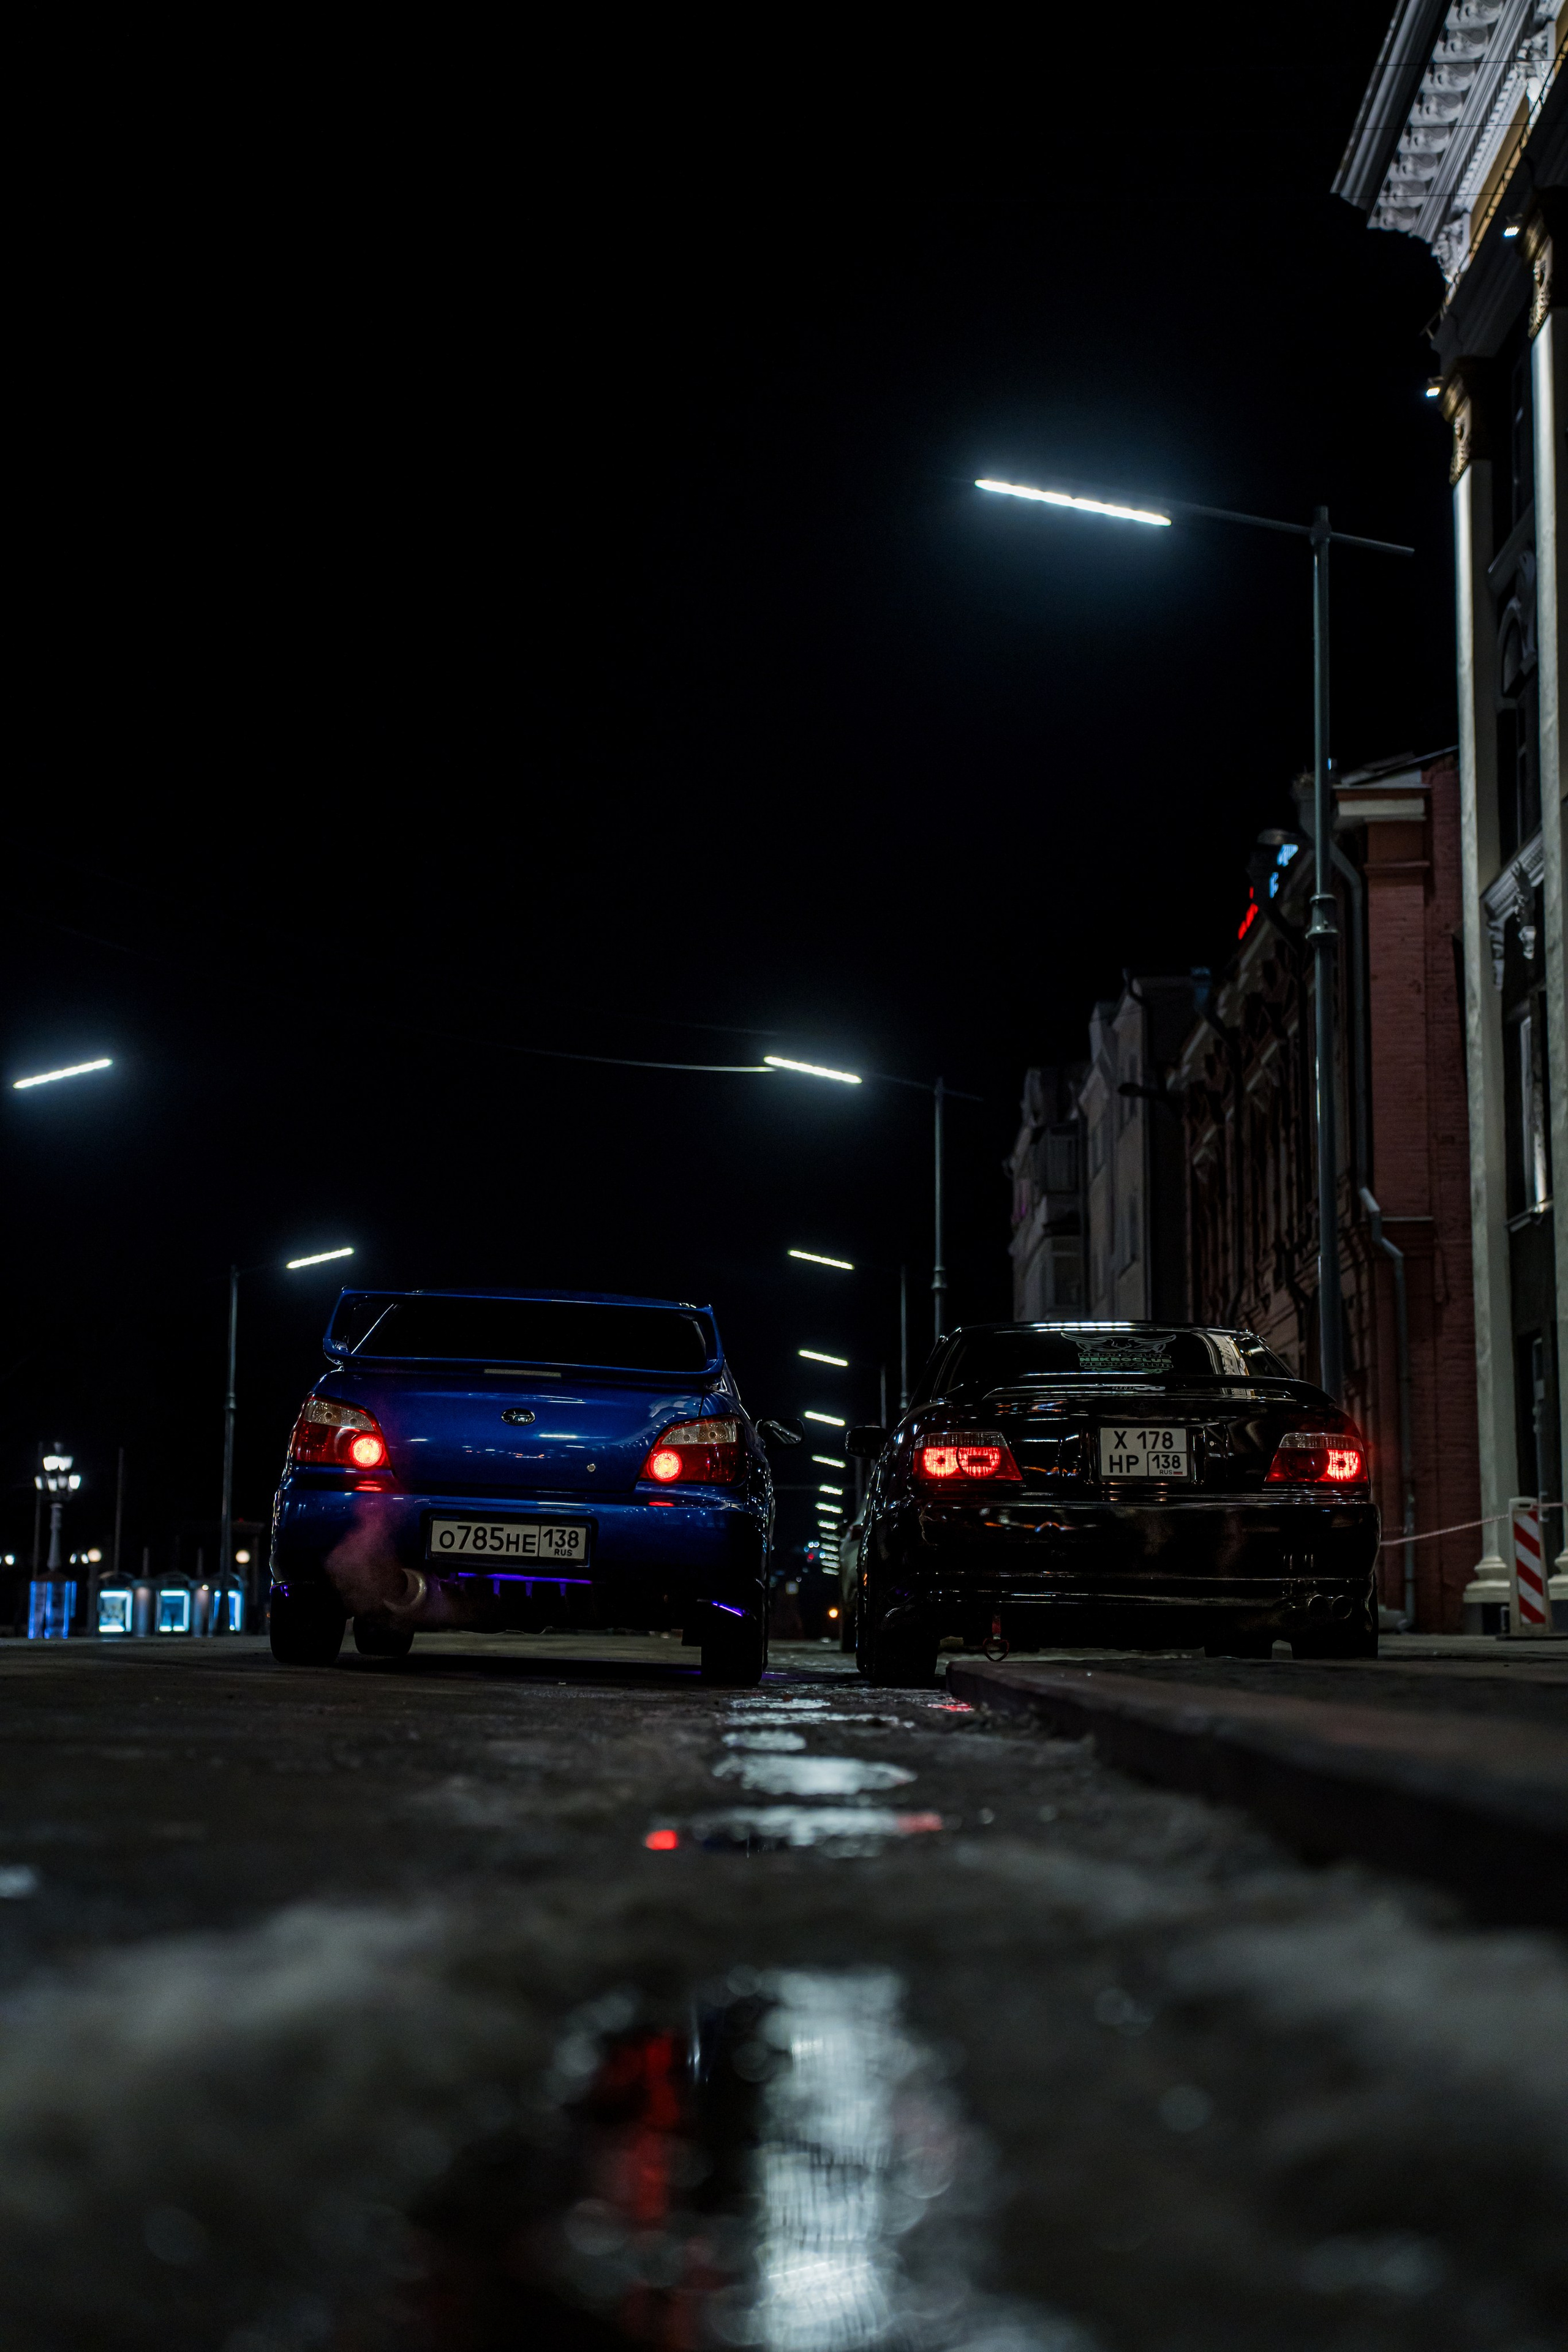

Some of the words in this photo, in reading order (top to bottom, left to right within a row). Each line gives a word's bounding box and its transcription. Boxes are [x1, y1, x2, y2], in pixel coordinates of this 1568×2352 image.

[1137, 1431, 1174, 1449] 178
[1152, 1454, 1181, 1469] 138
[543, 1529, 579, 1548] 138
